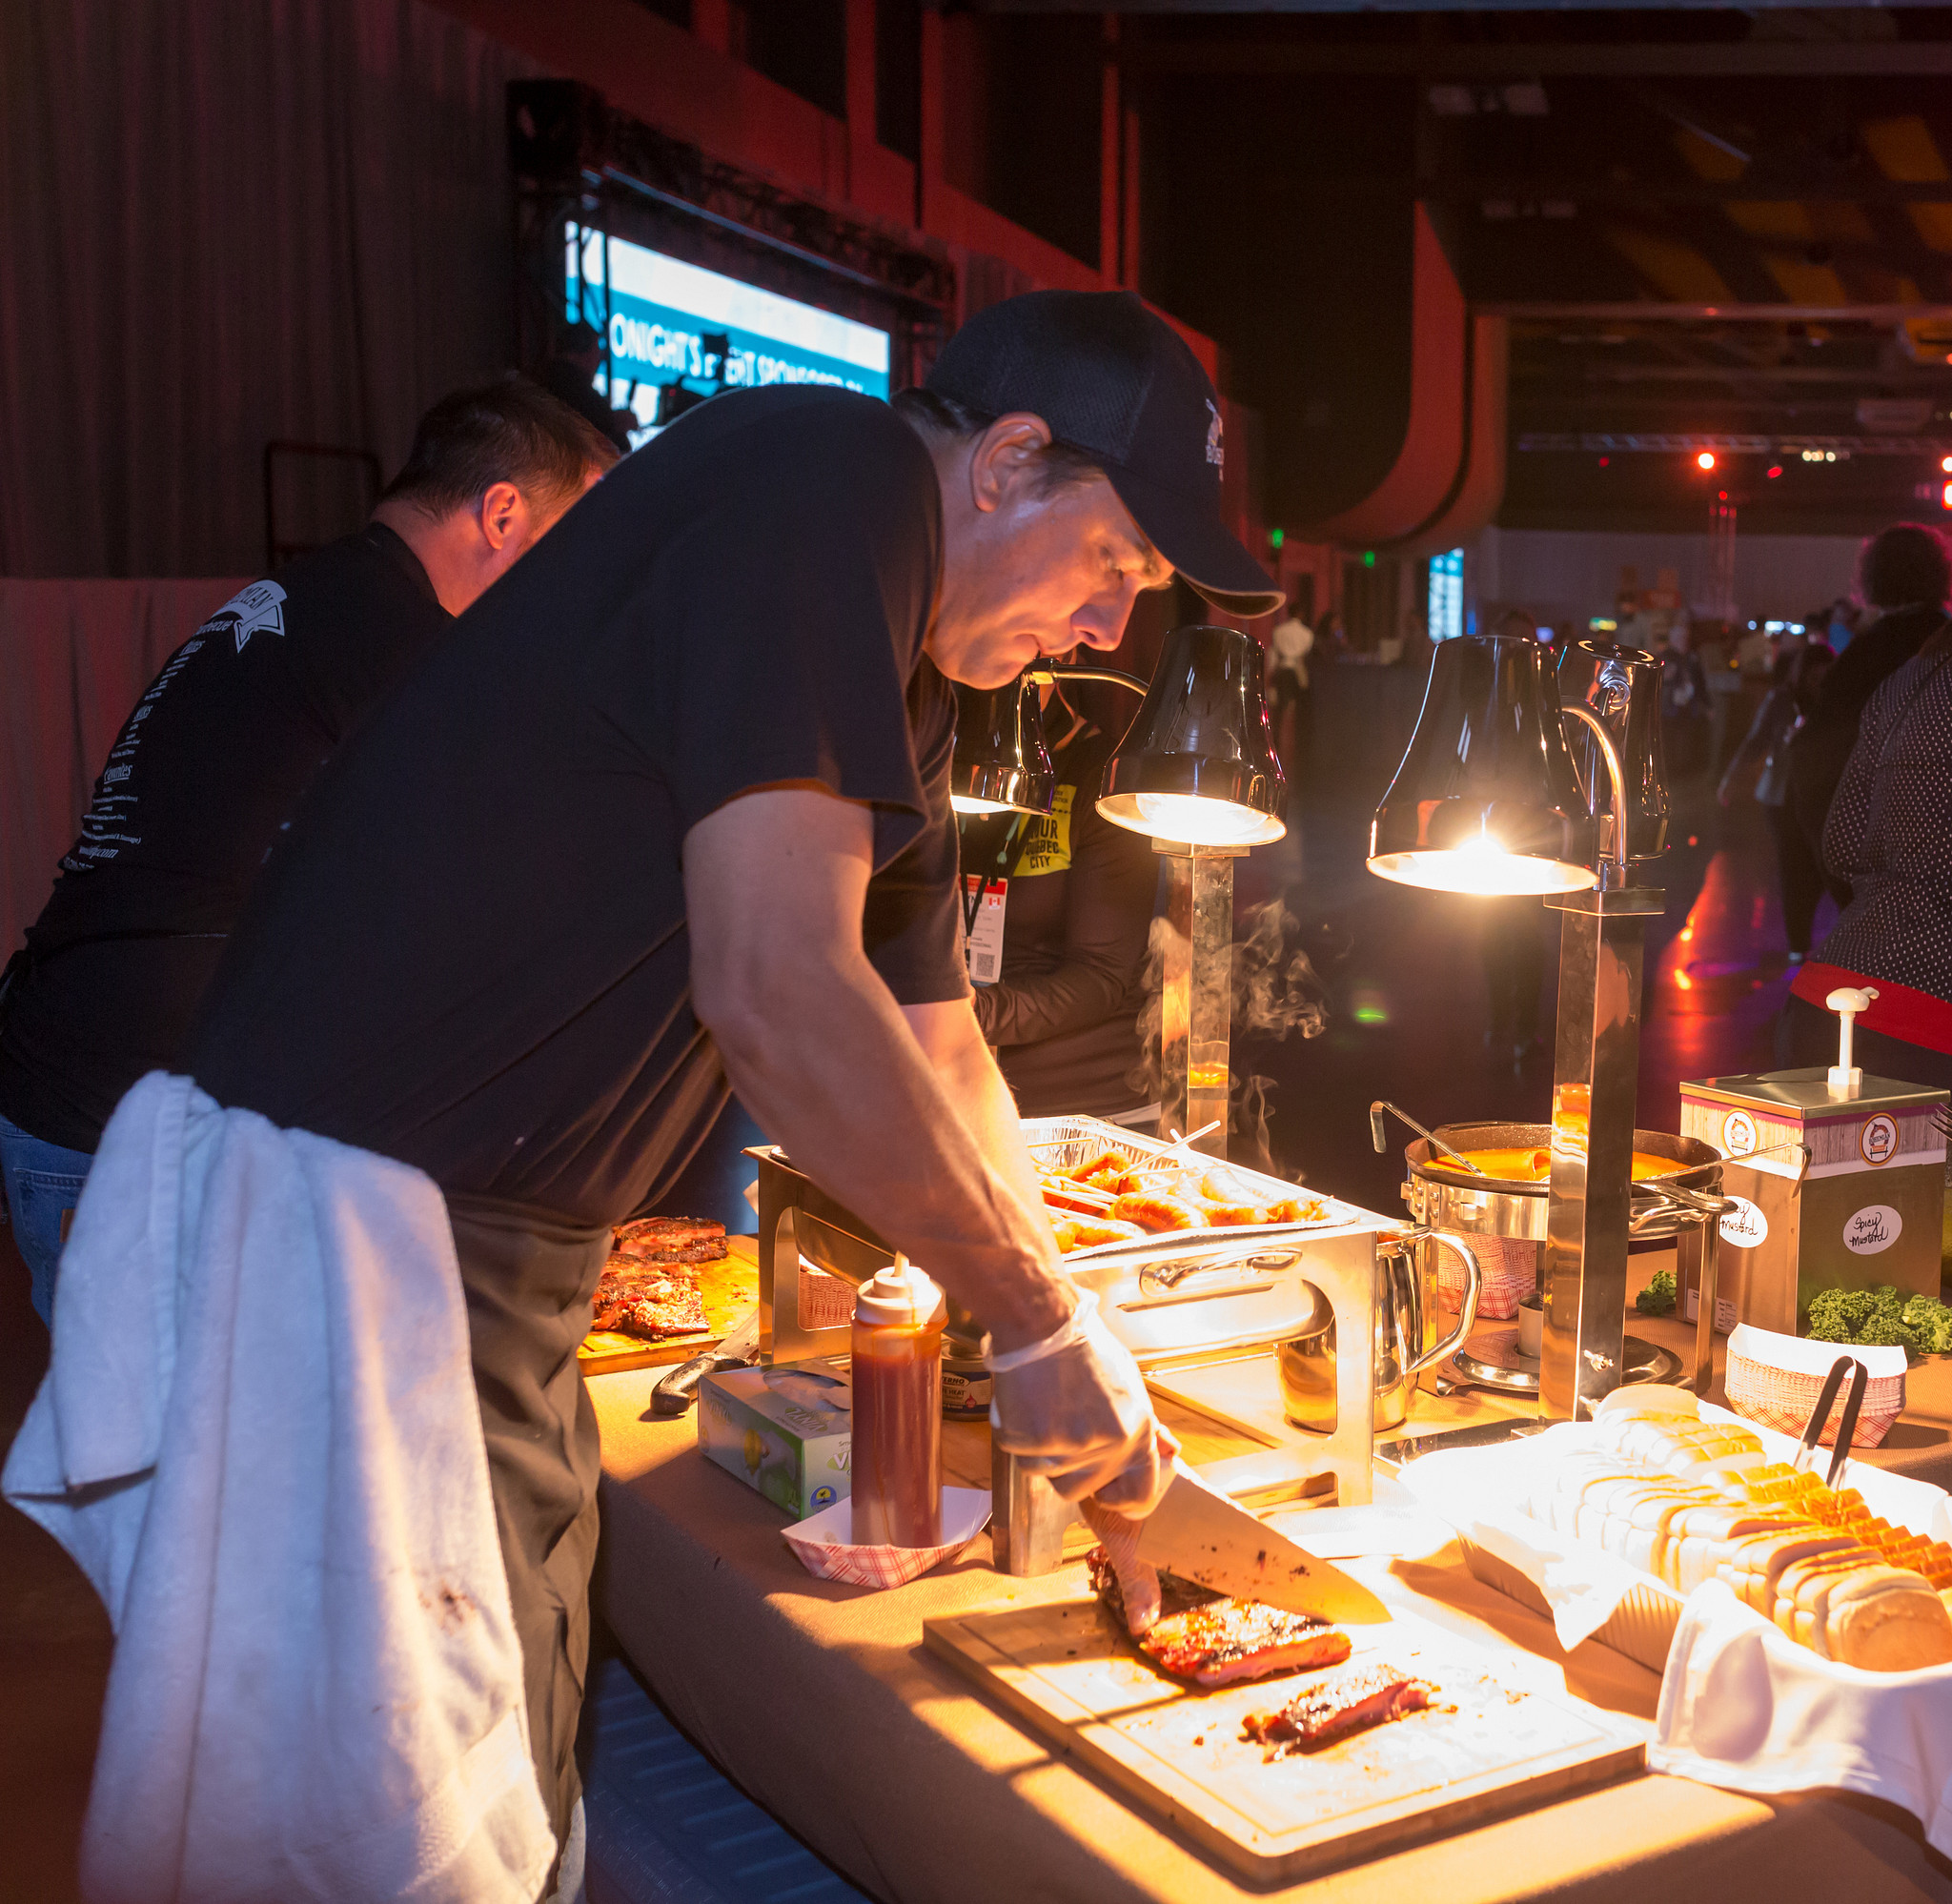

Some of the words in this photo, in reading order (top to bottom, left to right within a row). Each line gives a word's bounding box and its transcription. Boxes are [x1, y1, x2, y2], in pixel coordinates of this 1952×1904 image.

[610, 313, 702, 377] ONIGHT'S
[1029, 856, 1050, 869] CITY
[1853, 1211, 1882, 1237] Spicy
